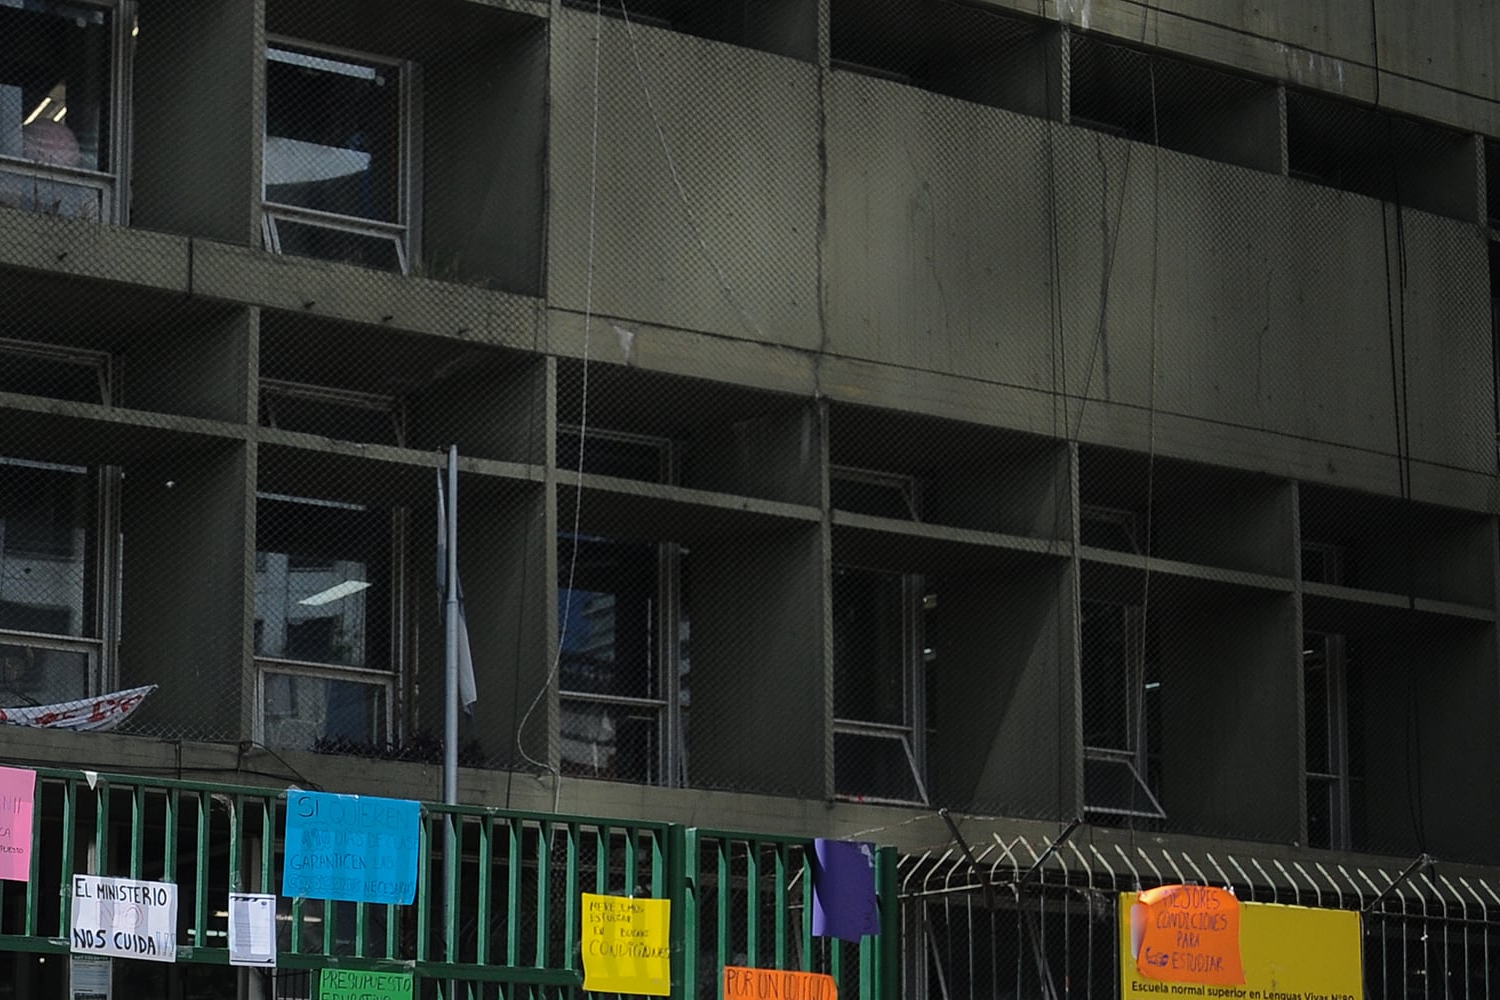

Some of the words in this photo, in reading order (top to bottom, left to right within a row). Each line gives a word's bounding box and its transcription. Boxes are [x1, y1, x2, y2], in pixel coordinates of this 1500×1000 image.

[298, 796, 319, 818] SI
[290, 852, 366, 871] GARANTICEN
[75, 877, 92, 898] EL
[96, 883, 168, 906] MINISTERIO
[96, 903, 144, 928] NO
[1156, 911, 1228, 932] CONDICIONES
[73, 928, 107, 949] NOS
[1176, 931, 1201, 948] PARA
[1171, 951, 1225, 973] ESTUDIAR
[322, 971, 411, 993] PRESUPUESTO
[726, 968, 754, 997] POR
[757, 972, 779, 999] UN
[1132, 980, 1169, 994] Escuela
[1171, 984, 1205, 996] normal
[1208, 986, 1247, 1000] superior
[1250, 990, 1261, 999] en
